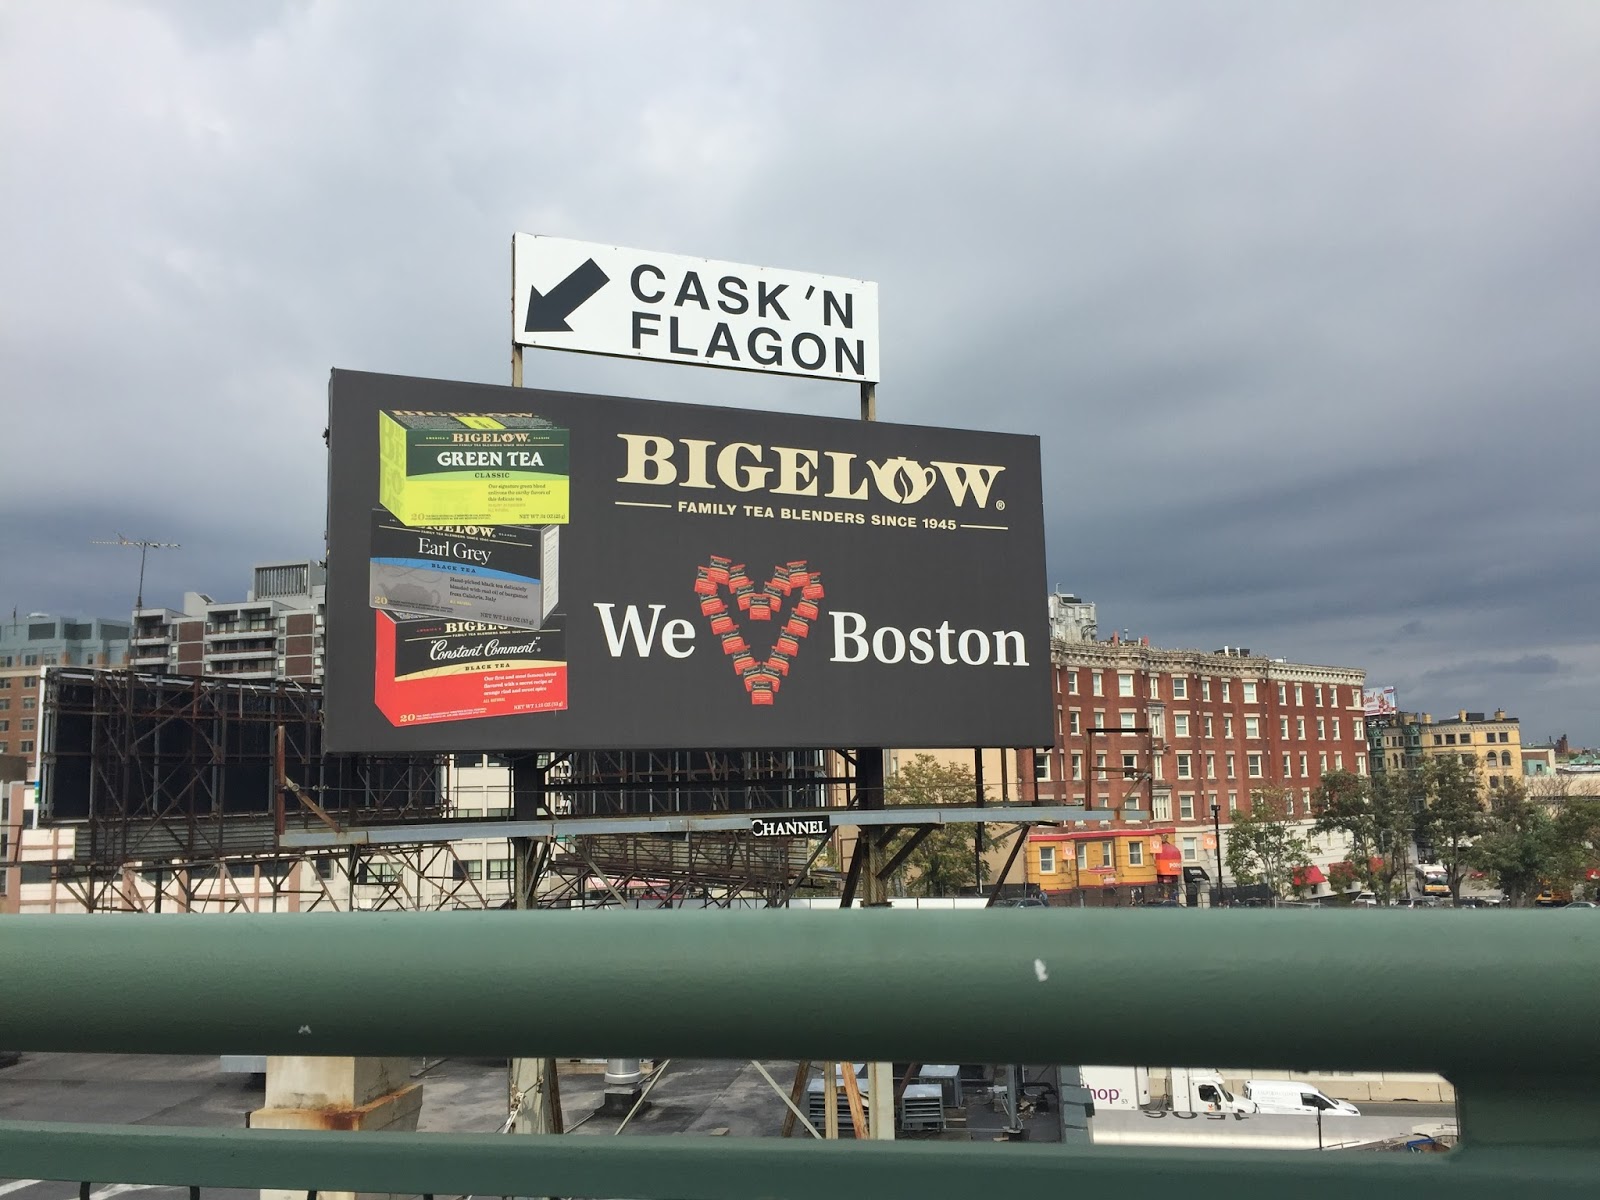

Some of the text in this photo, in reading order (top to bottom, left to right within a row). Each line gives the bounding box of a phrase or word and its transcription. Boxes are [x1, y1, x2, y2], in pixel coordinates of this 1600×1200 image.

[629, 264, 791, 321] CASK
[631, 311, 866, 376] FLAGON
[436, 451, 545, 467] GREEN TEA
[678, 501, 957, 531] FAMILY TEA BLENDERS SINCE 1945
[418, 537, 492, 565] Earl Grey
[431, 563, 459, 571] BLACK
[374, 595, 388, 605] 20
[593, 602, 1030, 667] We Boston
[400, 713, 416, 722] 20
[751, 819, 828, 837] CHANNEL
